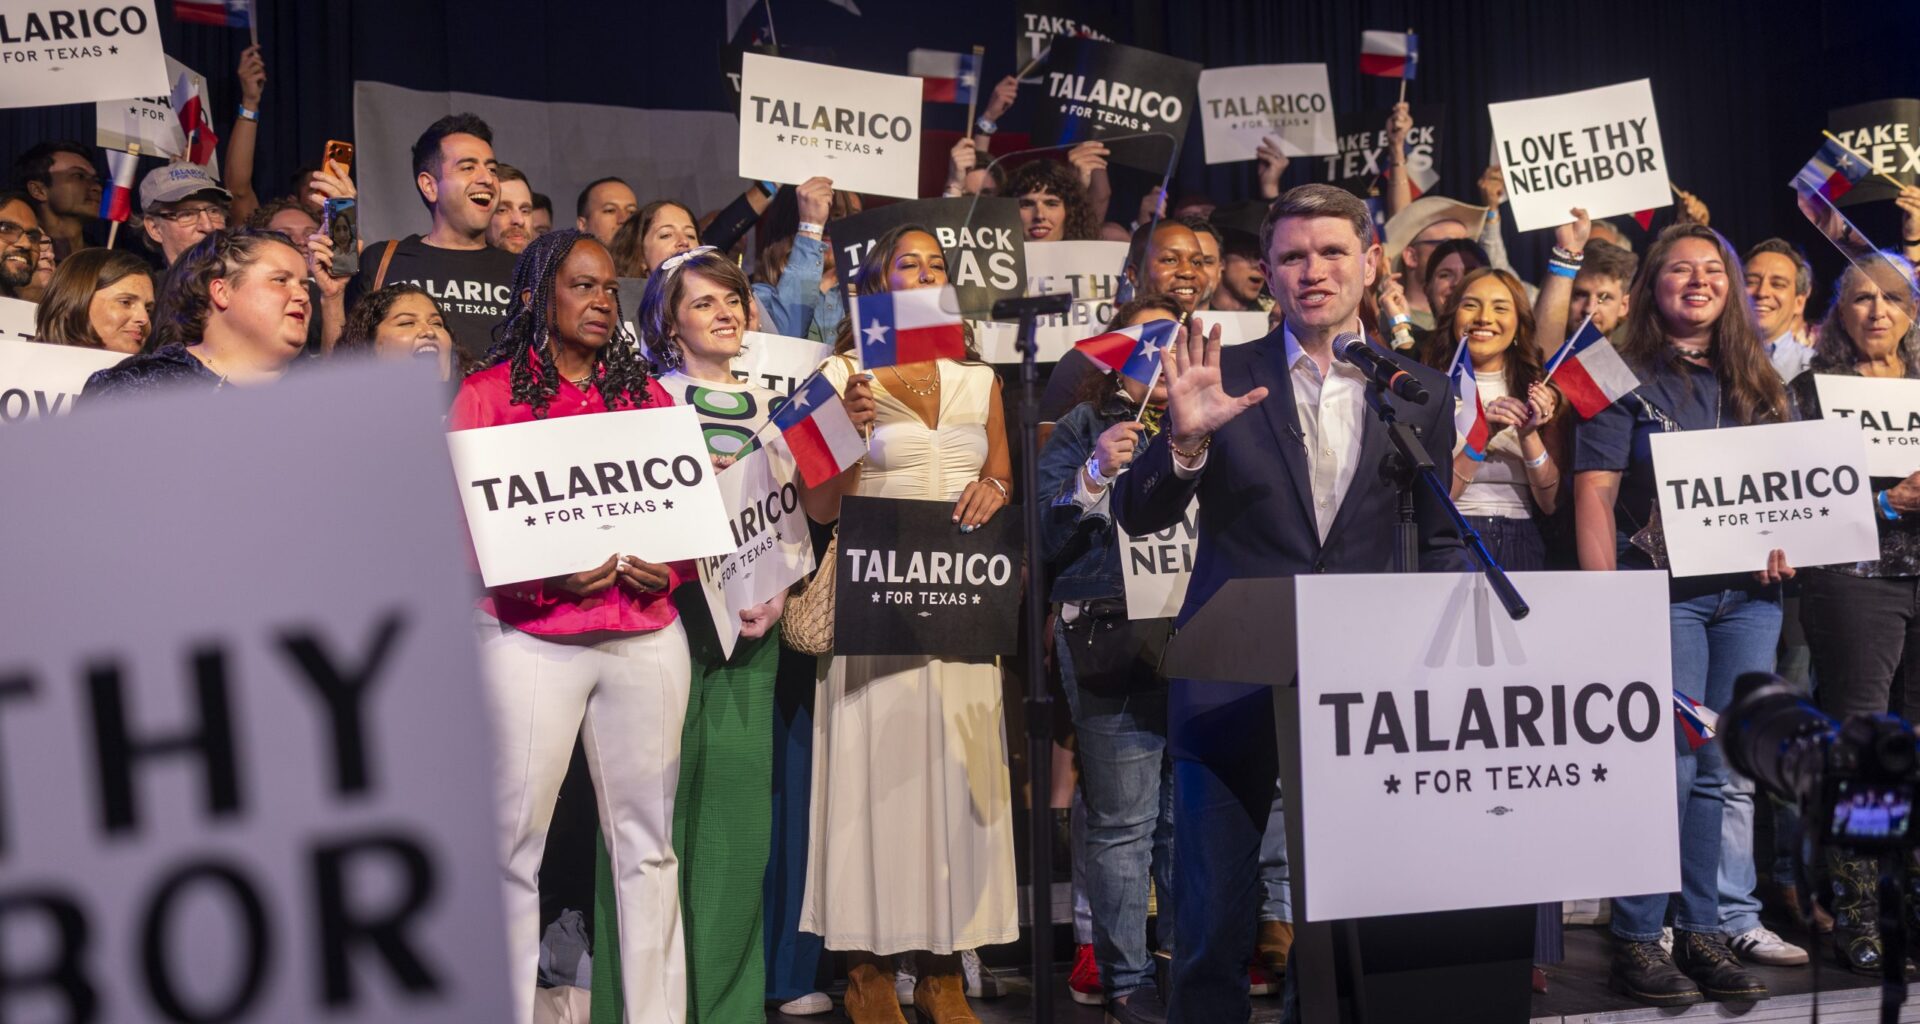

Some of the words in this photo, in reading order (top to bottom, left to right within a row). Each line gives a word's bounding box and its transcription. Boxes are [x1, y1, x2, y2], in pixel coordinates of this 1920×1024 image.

[1024, 13, 1076, 37] TAKE
[3, 50, 38, 63] FOR
[45, 45, 103, 60] TEXAS
[1050, 71, 1182, 123] TALARICO
[1207, 93, 1326, 119] TALARICO
[142, 107, 165, 121] FOR
[750, 95, 912, 142] TALARICO
[1069, 105, 1092, 119] FOR
[1097, 109, 1139, 130] TEXAS
[1241, 120, 1263, 129] FOR
[1266, 117, 1300, 127] TEXAS
[791, 135, 818, 147] FOR
[825, 138, 870, 154] TEXAS
[1378, 126, 1435, 147] BCK
[1504, 131, 1576, 167] LOVE
[1582, 117, 1647, 153] THY
[1838, 123, 1909, 149] TAKE
[1323, 144, 1434, 182] TEXS
[1510, 147, 1657, 195] NEIGHBOR
[936, 226, 1014, 251] BACK
[456, 303, 497, 316] TEXAS
[1887, 437, 1920, 446] FOR
[472, 455, 703, 511] TALARICO
[1666, 465, 1860, 510] TALARICO
[545, 507, 585, 525] FOR
[592, 499, 657, 518] TEXAS
[1719, 513, 1749, 527] FOR
[1756, 507, 1813, 524] TEXAS
[721, 561, 737, 586] FOR
[740, 536, 773, 567] TEXAS
[846, 549, 1011, 586] TALARICO
[885, 591, 913, 605] FOR
[919, 591, 967, 606] TEXAS
[1318, 681, 1660, 757] TALARICO
[1415, 769, 1472, 795] FOR
[1485, 762, 1581, 790] TEXAS
